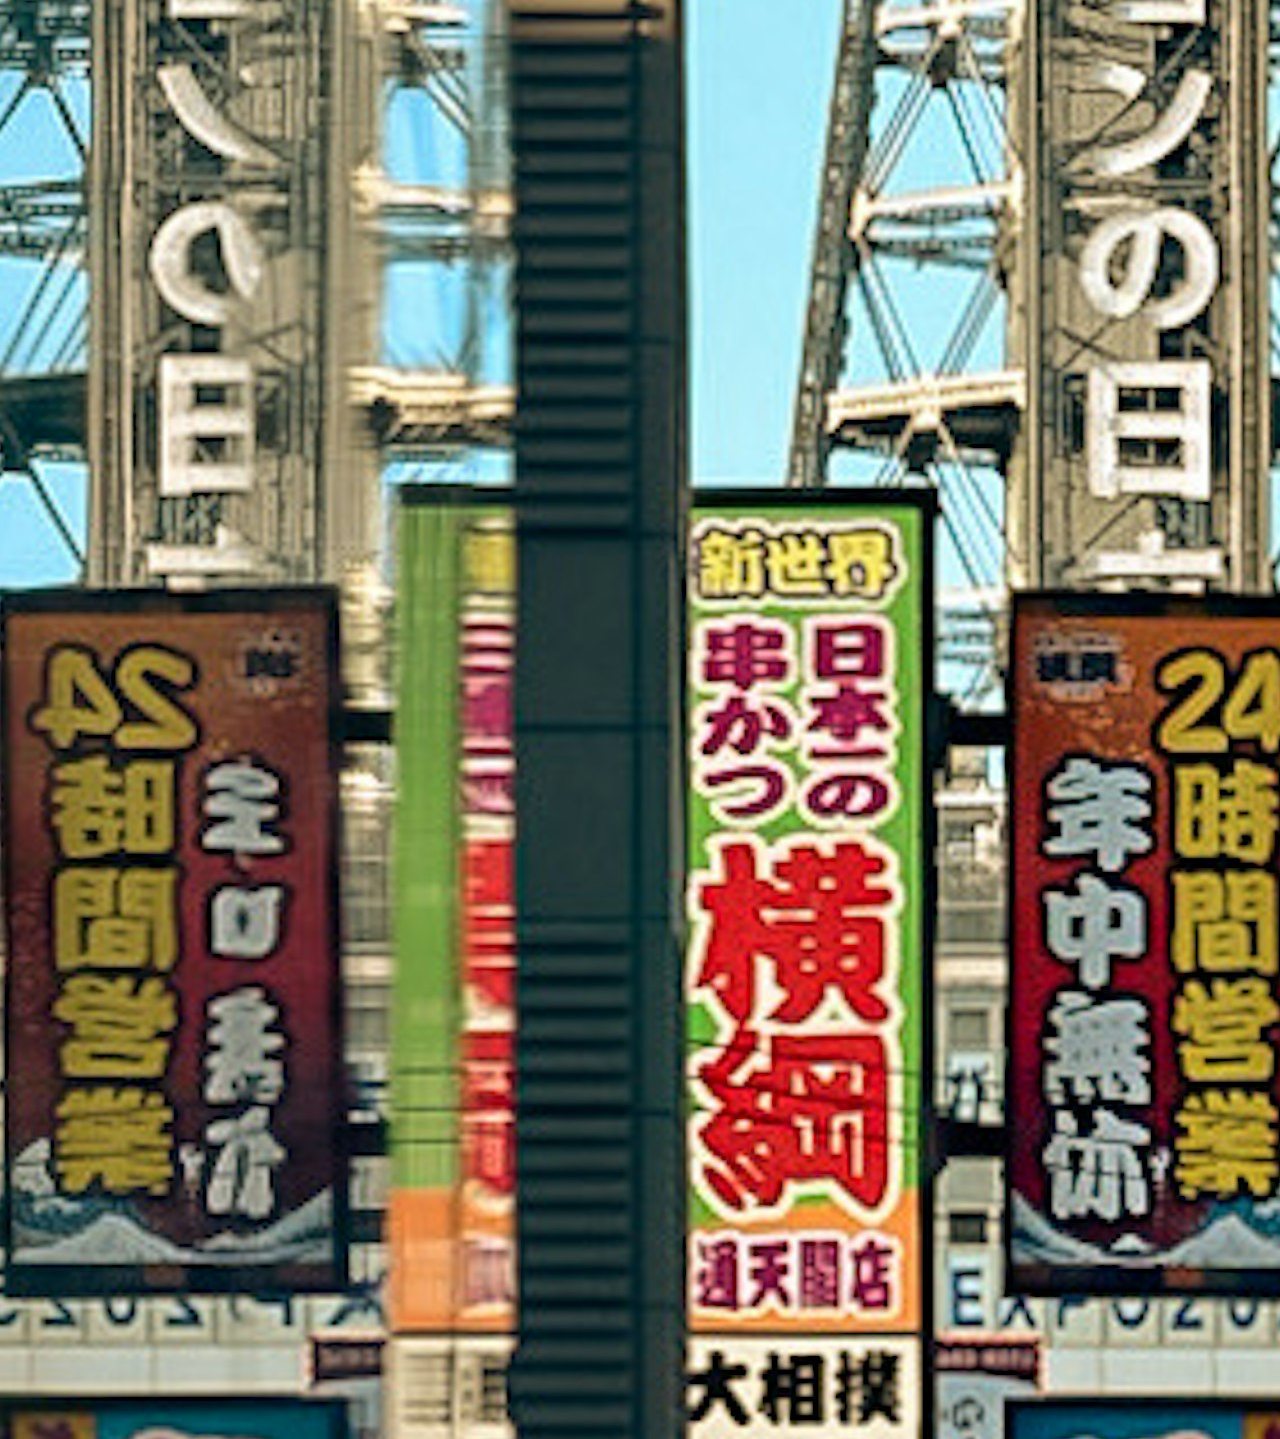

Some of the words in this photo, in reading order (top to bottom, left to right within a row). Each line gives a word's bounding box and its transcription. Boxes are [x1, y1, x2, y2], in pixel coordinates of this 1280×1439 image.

[699, 532, 895, 598] 新世界
[702, 625, 790, 815] 串かつ
[808, 624, 888, 816] 日本一の
[698, 843, 894, 1209] 横綱
[1043, 758, 1152, 1218] 年中無休
[698, 1241, 891, 1310] 通天閣店
[687, 1350, 902, 1425] 大相撲
